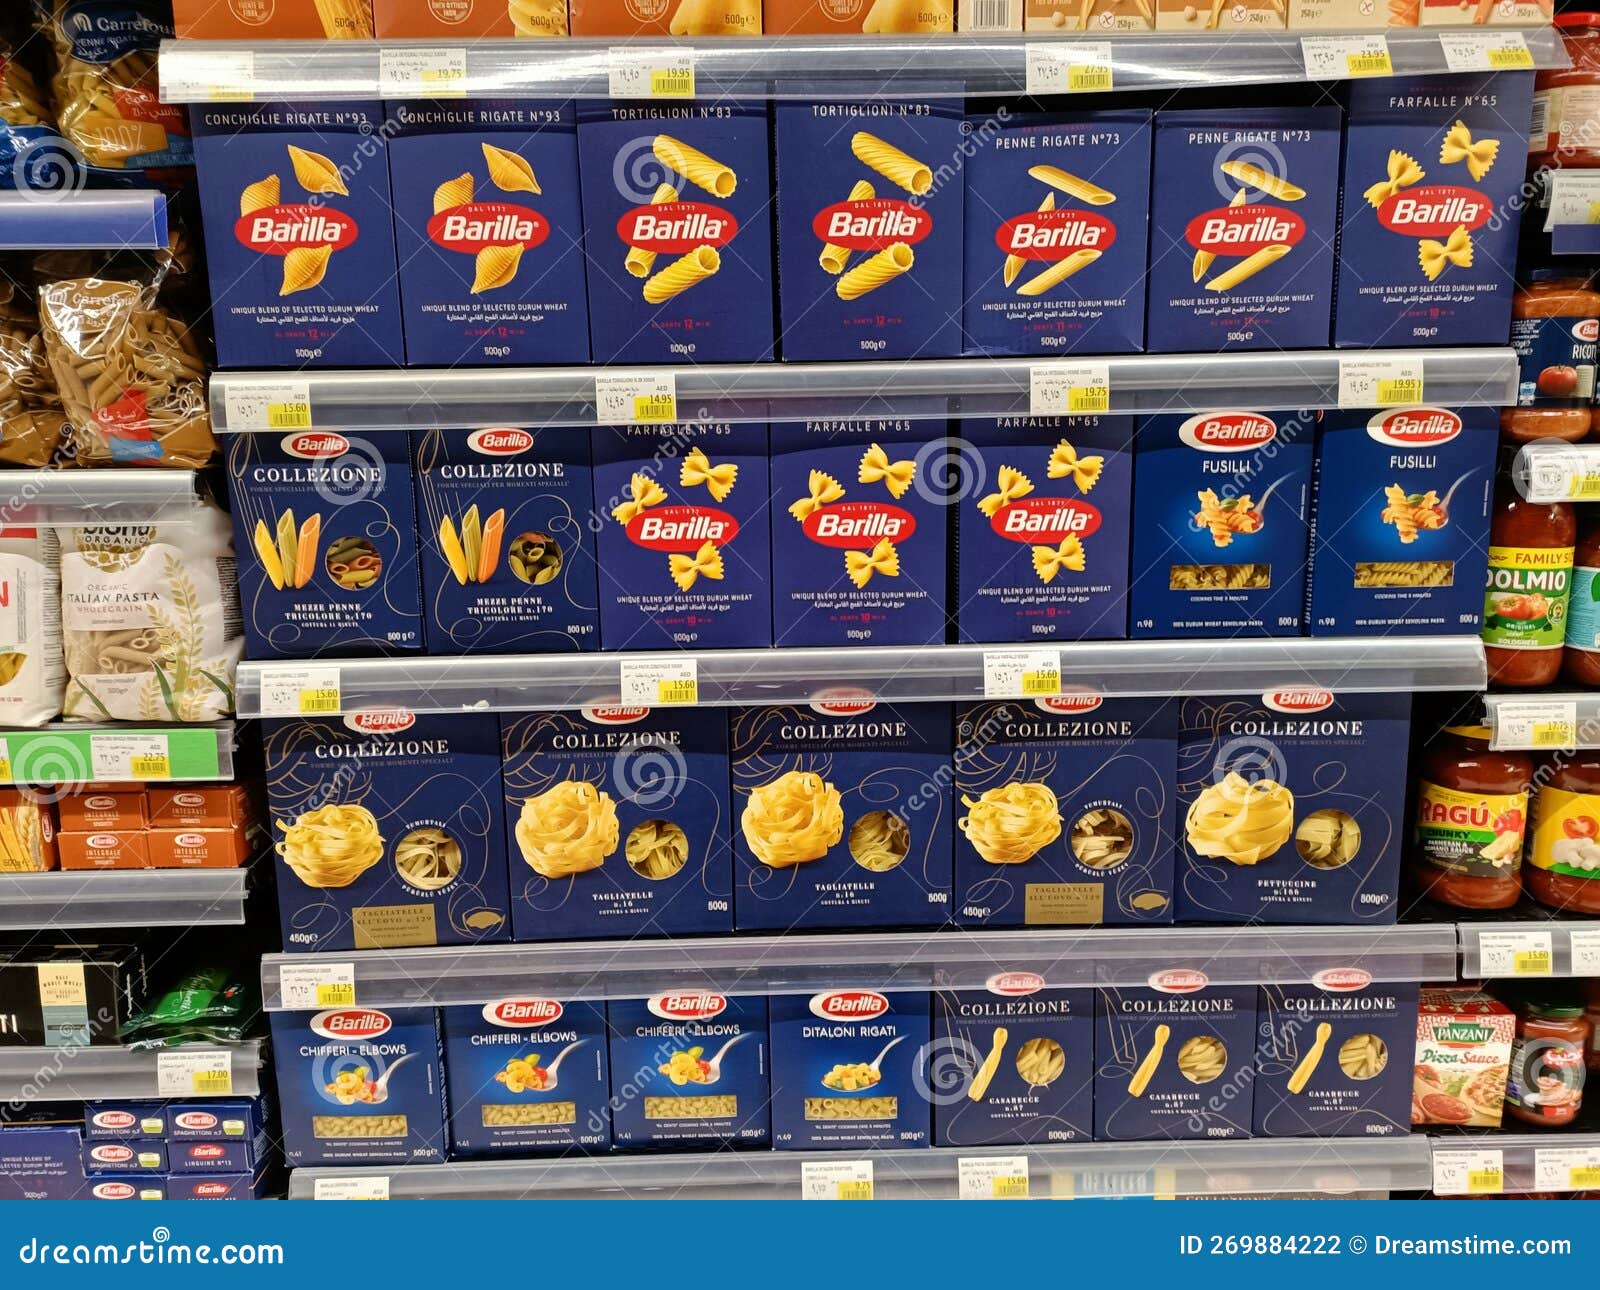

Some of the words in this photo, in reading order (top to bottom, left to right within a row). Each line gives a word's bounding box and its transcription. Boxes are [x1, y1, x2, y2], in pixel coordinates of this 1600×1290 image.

[1361, 50, 1385, 58] 23.95
[437, 68, 462, 79] 19.75
[666, 68, 690, 78] 19.95
[1390, 97, 1457, 108] FARFALLE
[400, 110, 475, 124] CONCHIGLIE
[481, 110, 524, 123] RIGATE
[612, 108, 694, 120] TORTIGLIONI
[812, 105, 893, 117] TORTIGLIONI
[205, 112, 280, 126] CONCHIGLIE
[286, 111, 330, 125] RIGATE
[996, 137, 1036, 149] PENNE
[1042, 135, 1085, 147] RIGATE
[1189, 132, 1229, 144] PENNE
[1235, 130, 1277, 142] RIGATE
[1392, 198, 1478, 224] Barilla
[251, 217, 342, 243] Barilla
[443, 215, 534, 242] Barilla
[632, 214, 722, 241] Barilla
[828, 212, 917, 237] Barilla
[1200, 218, 1291, 245] Barilla
[1010, 221, 1102, 249] Barilla
[1359, 287, 1384, 295] UNIQUE
[1044, 301, 1076, 309] SELECTED
[1078, 300, 1102, 308] DURUM
[1104, 299, 1126, 307] WHEAT
[649, 394, 672, 404] 14.95
[1085, 387, 1107, 398] 19.75
[282, 403, 307, 413] 15.60
[627, 424, 691, 435] FARFALLE
[806, 421, 871, 432] FARFALLE
[997, 417, 1061, 428] FARFALLE
[1389, 416, 1454, 435] Barilla
[1202, 421, 1266, 440] Barilla
[297, 438, 344, 452] Barilla
[482, 434, 528, 448] Barilla
[1202, 459, 1250, 473] FUSILLI
[1390, 455, 1436, 469] FUSILLI
[253, 467, 382, 483] COLLEZIONE
[440, 463, 564, 479] COLLEZIONE
[816, 514, 901, 538] Barilla
[1004, 510, 1088, 533] Barilla
[640, 517, 724, 541] Barilla
[1515, 552, 1562, 564] FAMILY
[115, 592, 160, 602] PASTA
[510, 597, 542, 605] PENNE
[328, 603, 361, 612] PENNE
[467, 606, 523, 614] TRICOLORE
[284, 612, 341, 621] TRICOLORE
[1036, 670, 1057, 679] 15.60
[673, 680, 695, 689] 15.60
[315, 688, 338, 699] 15.60
[1278, 690, 1329, 705] Barilla
[781, 722, 907, 740] COLLEZIONE
[1005, 721, 1132, 737] COLLEZIONE
[1230, 721, 1363, 736] COLLEZIONE
[552, 730, 682, 750] COLLEZIONE
[315, 739, 449, 759] COLLEZIONE
[143, 752, 165, 761] 22.75
[1422, 798, 1489, 827] RAGÚ
[815, 883, 875, 891] TAGLIATELLE
[1258, 880, 1317, 888] FETTUCCINE
[592, 891, 653, 901] TAGLIATELLE
[1527, 951, 1549, 959] 15.60
[331, 983, 352, 993] 31.25
[501, 1002, 556, 1018] Barilla
[666, 996, 720, 1012] Barilla
[827, 996, 882, 1012] Barilla
[960, 1000, 1070, 1016] COLLEZIONE
[1122, 999, 1234, 1013] COLLEZIONE
[1284, 997, 1396, 1011] COLLEZIONE
[328, 1016, 384, 1032] Barilla
[636, 1026, 685, 1037] CHIFFERI
[694, 1024, 740, 1036] ELBOWS
[471, 1034, 521, 1046] CHIFFERI
[531, 1031, 577, 1043] ELBOWS
[803, 1026, 855, 1038] DITALONI
[860, 1025, 896, 1037] RIGATI
[1437, 1027, 1489, 1042] PANZANI
[300, 1045, 349, 1057] CHIFFERI
[360, 1044, 407, 1056] ELBOWS
[1419, 1049, 1458, 1064] Pizza
[1461, 1052, 1500, 1064] Sauce
[207, 1071, 228, 1079] 17.00
[989, 1097, 1040, 1105] CASARECCE
[1149, 1093, 1200, 1101] CASARECCE
[1308, 1090, 1359, 1098] CASARECCE
[1007, 1177, 1026, 1185] 15.60
